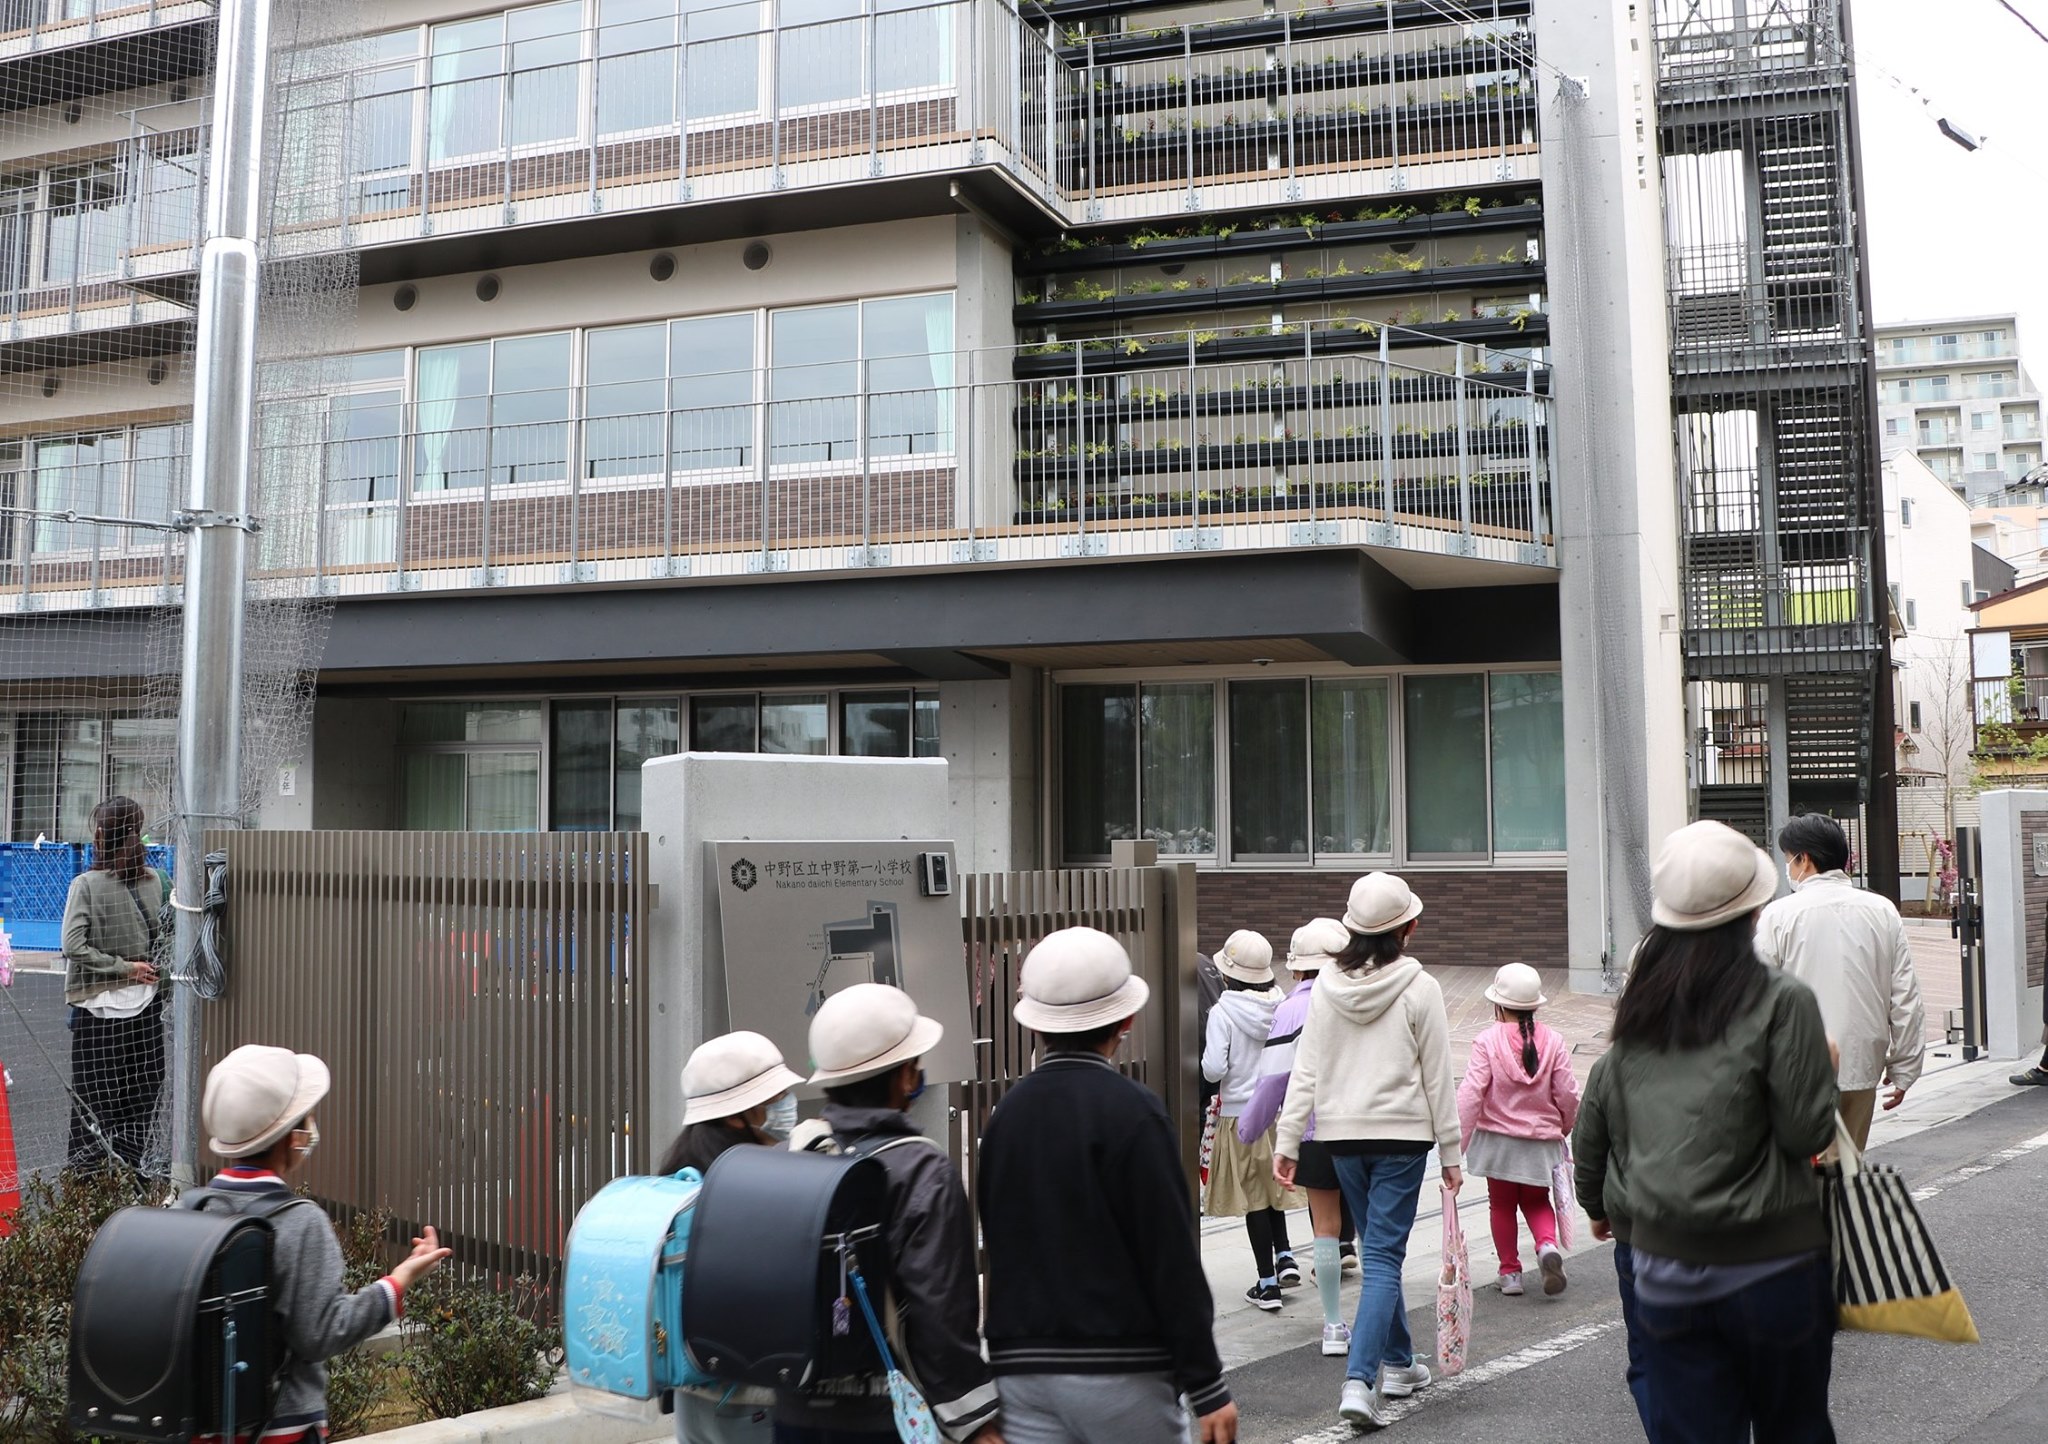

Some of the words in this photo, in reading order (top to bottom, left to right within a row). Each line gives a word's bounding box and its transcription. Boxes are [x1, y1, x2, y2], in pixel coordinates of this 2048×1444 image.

[764, 859, 912, 877] 中野区立中野第一小学校
[776, 880, 806, 888] Nakano
[808, 879, 833, 888] daiichi
[835, 878, 877, 887] Elementary
[880, 877, 904, 886] School
